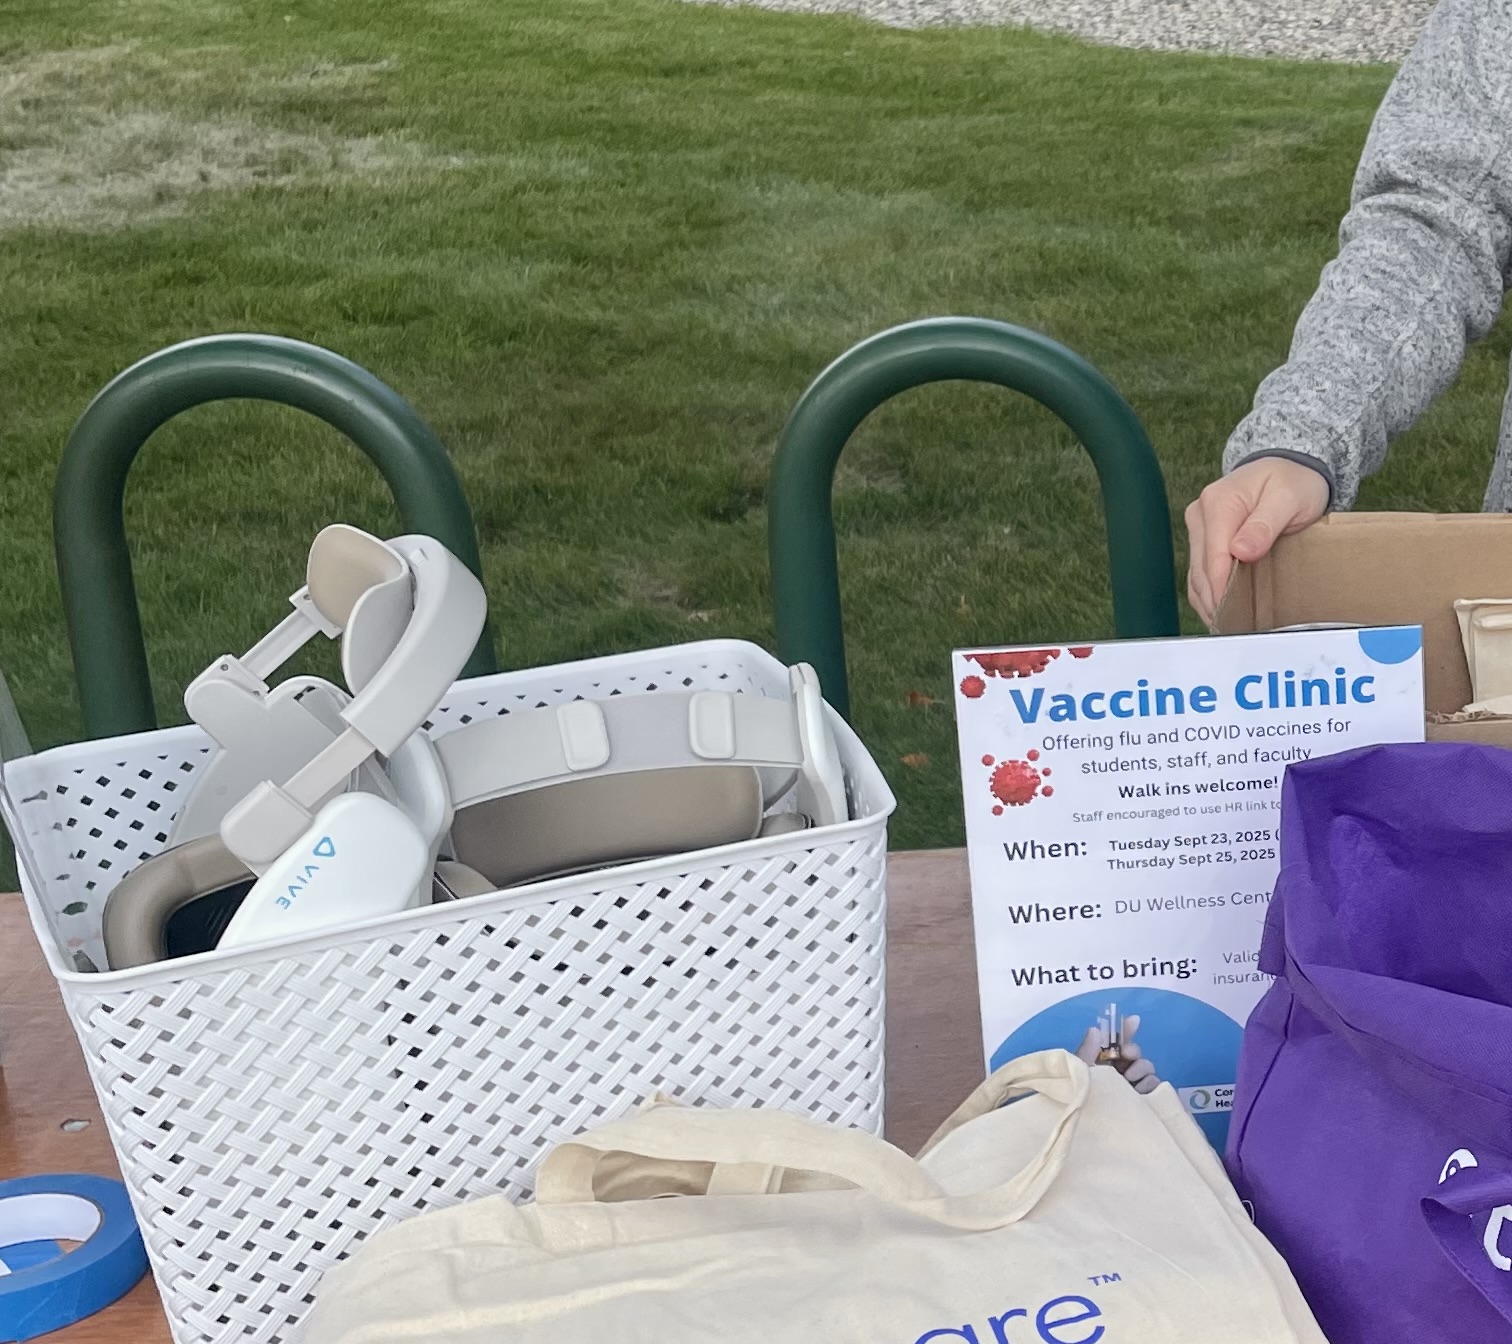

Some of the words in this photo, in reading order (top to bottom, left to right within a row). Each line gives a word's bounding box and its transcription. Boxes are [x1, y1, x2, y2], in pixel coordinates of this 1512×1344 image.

[1009, 679, 1218, 724] Vaccine
[1234, 667, 1376, 711] Clinic
[1042, 733, 1114, 751] Offering
[1119, 731, 1142, 746] flu
[1147, 728, 1179, 744] and
[1184, 724, 1241, 742] COVID
[1246, 720, 1322, 738] vaccines
[1326, 718, 1352, 733] for
[1081, 757, 1162, 775] students,
[1167, 751, 1212, 769] staff,
[1216, 748, 1248, 766] and
[1253, 745, 1312, 763] faculty
[1118, 783, 1162, 799] Walk
[1165, 782, 1191, 796] ins
[1195, 776, 1279, 794] welcome!
[1072, 810, 1105, 823] Staff
[1106, 806, 1180, 821] encouraged
[1183, 806, 1197, 815] to
[1200, 804, 1222, 814] use
[1225, 802, 1243, 812] HR
[1246, 800, 1268, 811] link
[1003, 839, 1088, 861] When:
[1109, 837, 1171, 852] Tuesday
[1174, 834, 1209, 848] Sept
[1210, 832, 1232, 846] 23,
[1235, 830, 1271, 843] 2025
[1107, 856, 1175, 871] Thursday
[1178, 852, 1212, 867] Sept
[1216, 851, 1237, 864] 25,
[1240, 848, 1276, 861] 2025
[275, 865, 320, 910] VIVE
[1008, 903, 1102, 924] Where:
[1115, 899, 1141, 914] DU
[1146, 895, 1226, 912] Wellness
[1011, 964, 1081, 987] What
[1086, 964, 1115, 981] to
[1122, 957, 1198, 980] bring:
